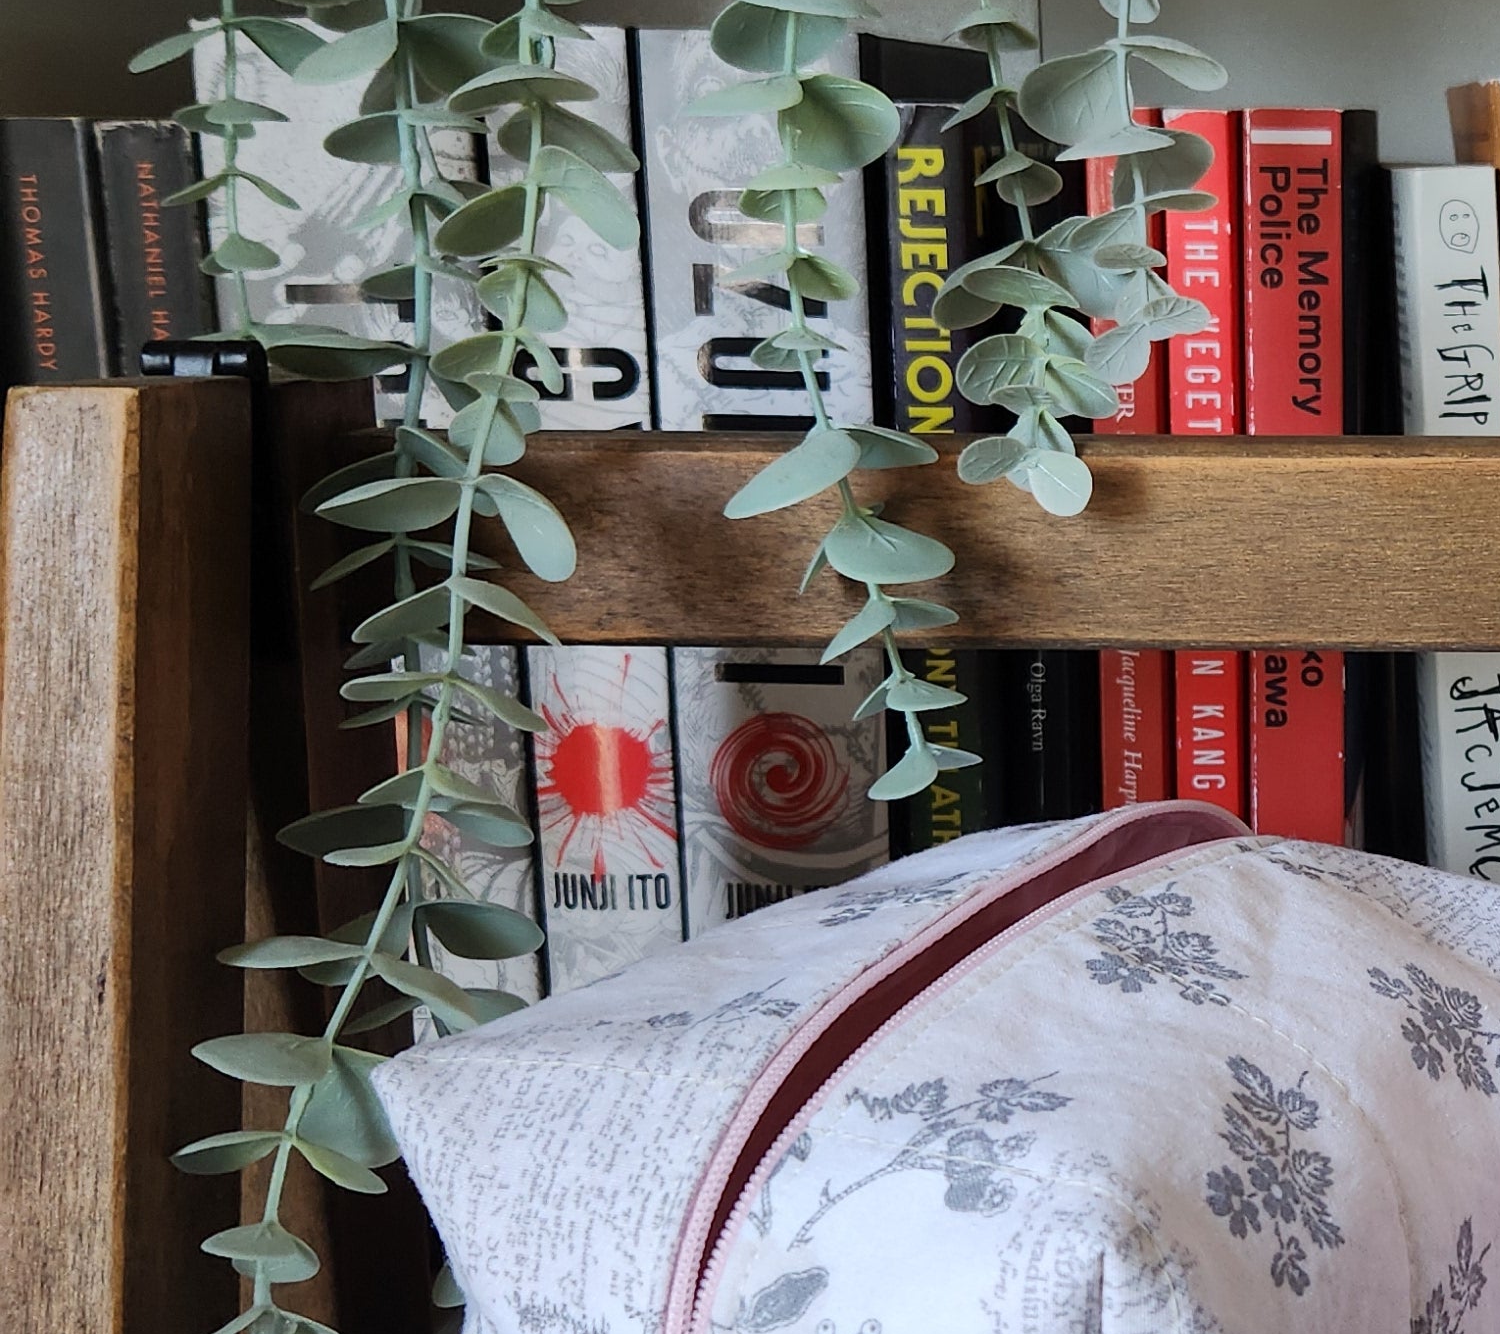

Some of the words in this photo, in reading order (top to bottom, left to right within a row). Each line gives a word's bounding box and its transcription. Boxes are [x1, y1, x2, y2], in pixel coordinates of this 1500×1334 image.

[19, 174, 47, 280] THOMAS
[138, 162, 168, 301] NATHANIEL
[1259, 166, 1291, 290] Police
[1296, 159, 1329, 236] The
[895, 147, 955, 435] REJECTION
[1184, 219, 1220, 288] THE
[27, 290, 59, 371] HARDY
[1291, 250, 1329, 417] Memory
[1437, 346, 1495, 426] GRIP
[1027, 662, 1046, 703] Olga
[1031, 708, 1047, 752] Ravn
[1192, 703, 1227, 791] KANG
[553, 872, 621, 910] JUNJI
[628, 872, 672, 909] ITO
